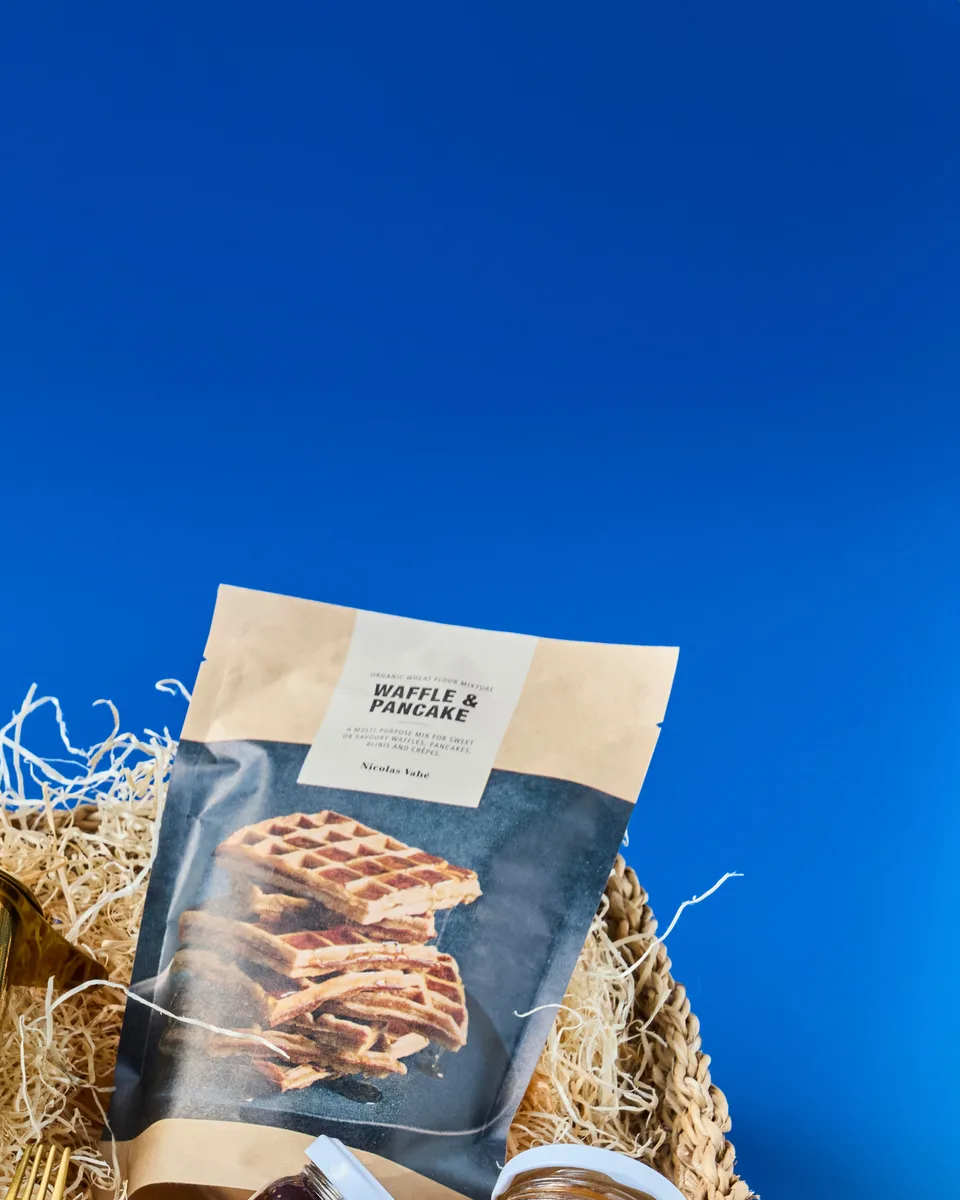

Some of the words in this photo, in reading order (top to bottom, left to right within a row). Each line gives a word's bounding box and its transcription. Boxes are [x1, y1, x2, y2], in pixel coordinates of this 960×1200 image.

[370, 672, 404, 680] ORGANIC
[434, 676, 458, 685] FLOUR
[460, 681, 494, 692] MIXTURE
[374, 683, 457, 703] WAFFLE
[462, 694, 478, 708] &
[369, 699, 470, 722] PANCAKE
[392, 736, 426, 746] WAFFLES,
[430, 741, 472, 754] PANCAKES,
[449, 737, 474, 746] SWEET
[360, 761, 401, 775] Nicolas
[404, 768, 430, 779] Vahé
